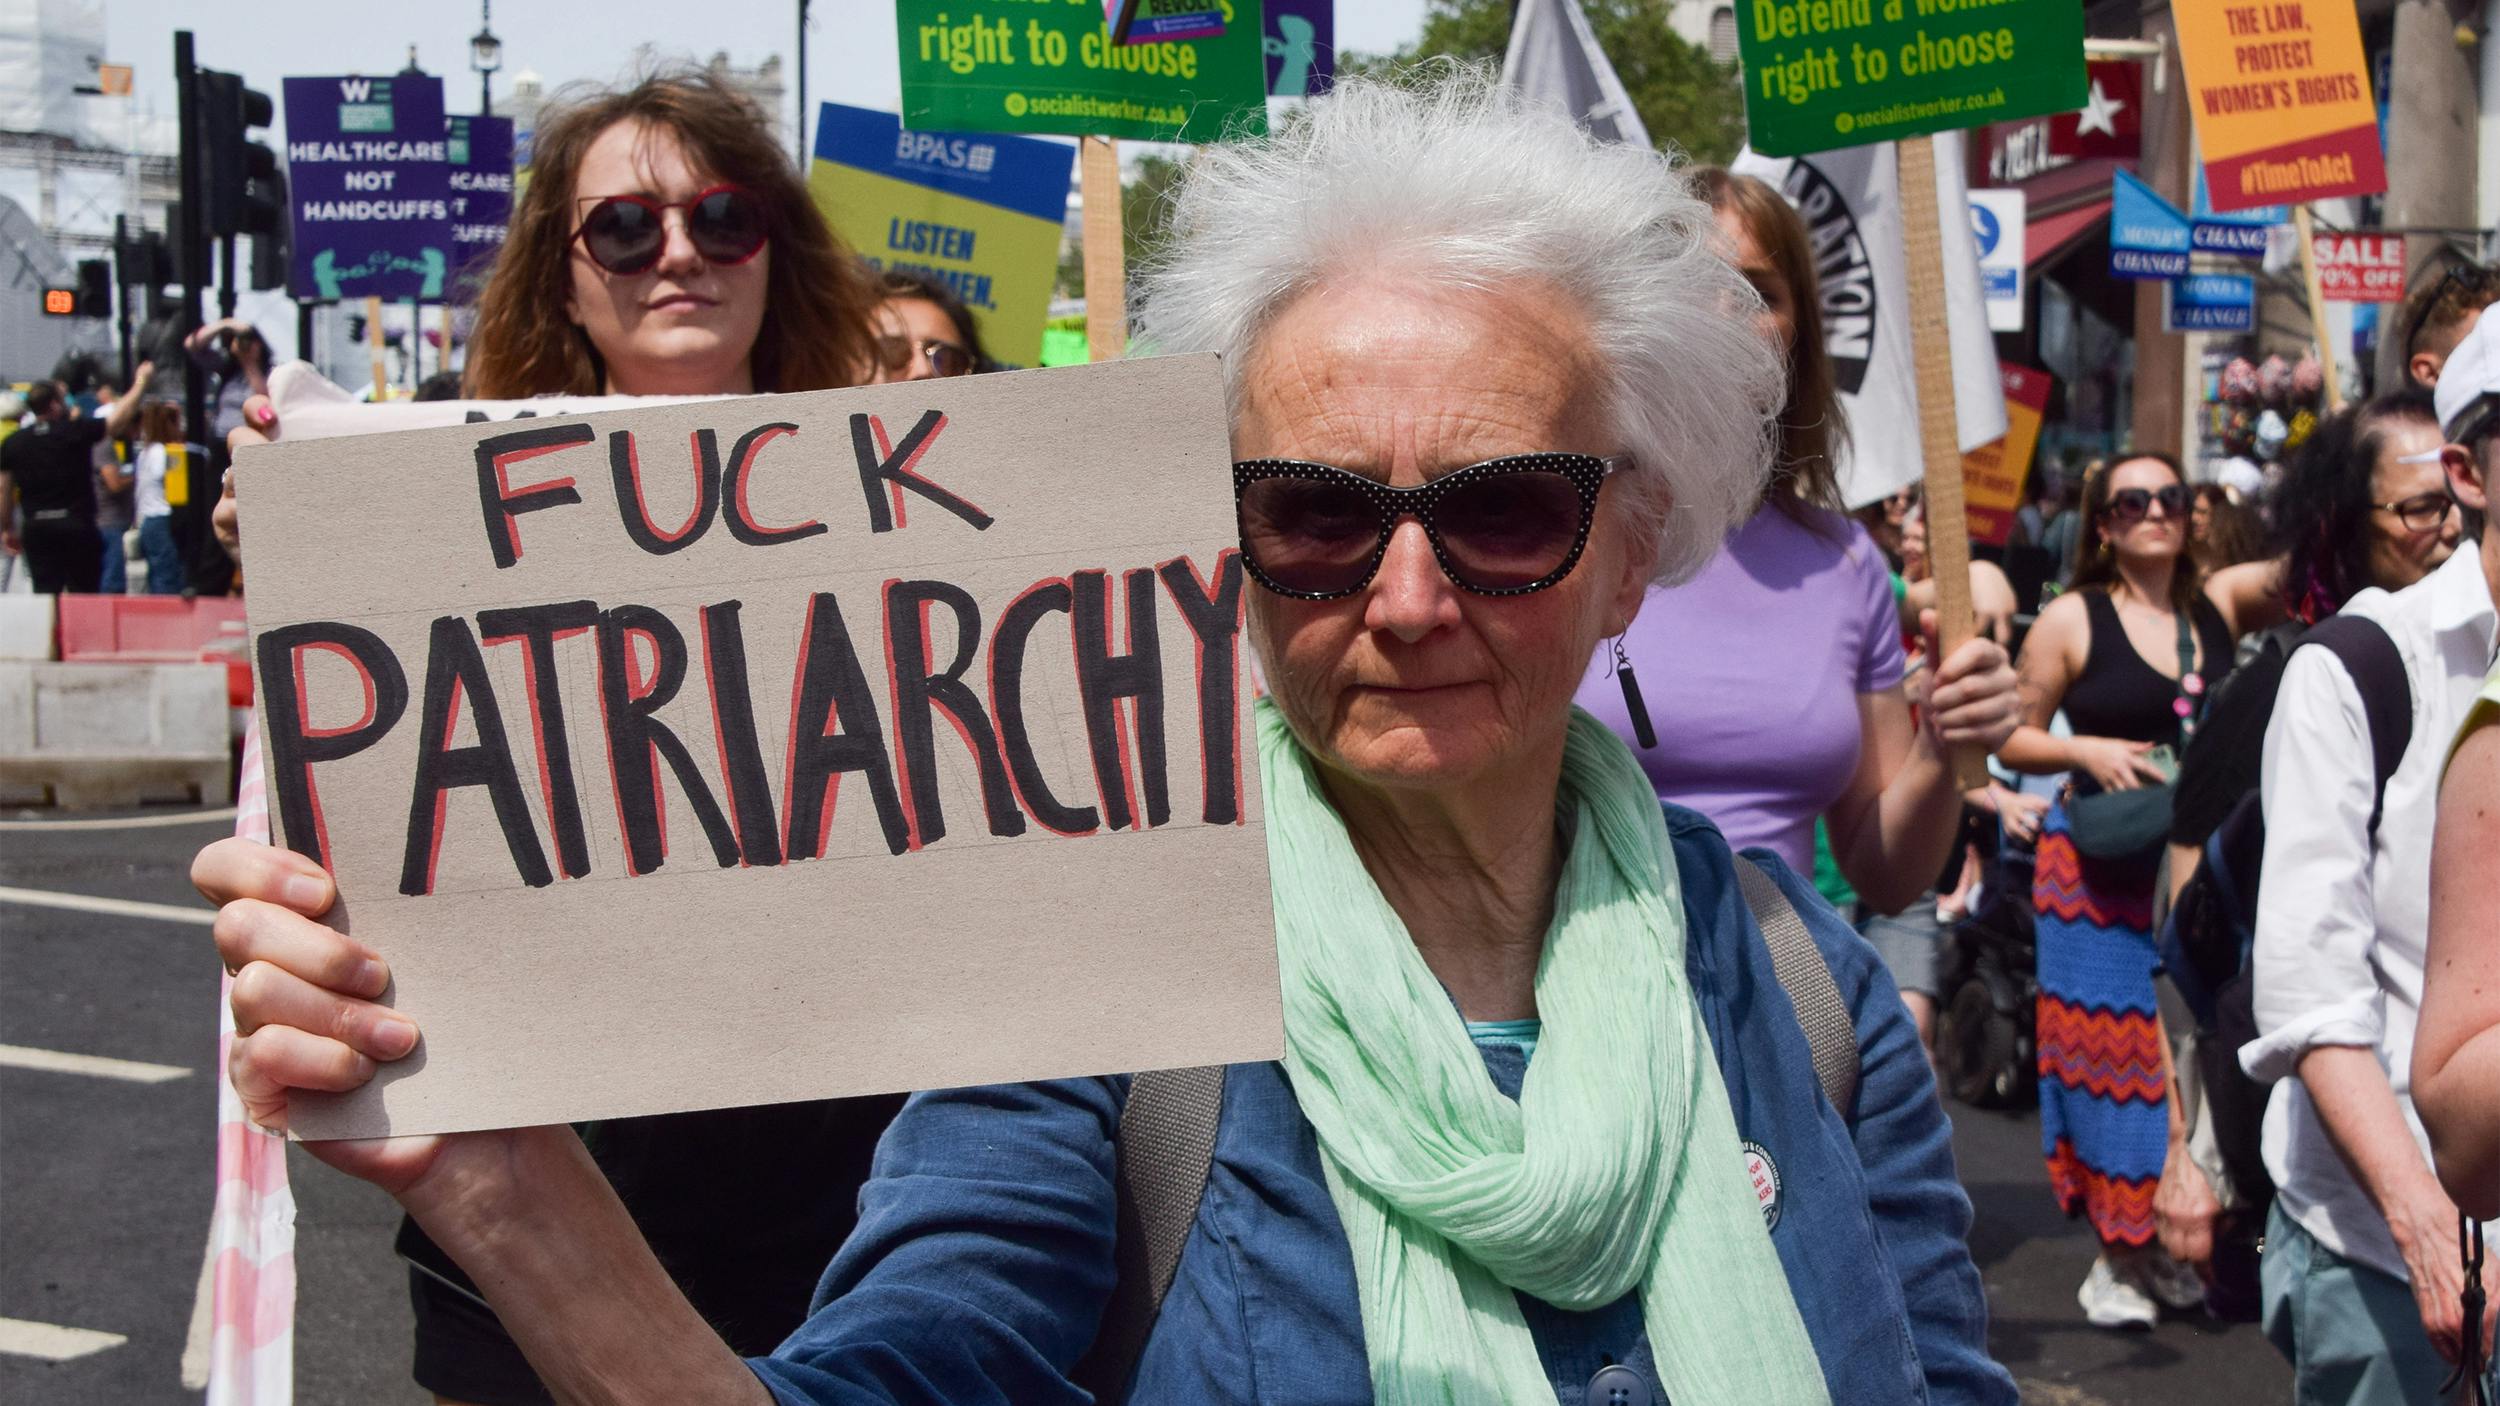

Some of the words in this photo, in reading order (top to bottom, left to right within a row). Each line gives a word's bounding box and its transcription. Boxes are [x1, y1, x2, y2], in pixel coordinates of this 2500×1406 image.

[2225, 8, 2260, 36] THE
[919, 13, 1014, 73] right
[1026, 18, 1068, 66] to
[2235, 40, 2313, 73] PROTECT
[1760, 47, 1841, 105] right
[1851, 42, 1888, 84] to
[1900, 27, 2015, 77] choose
[1030, 93, 1187, 125] socialistworker.co.uk
[1855, 87, 2006, 129] socialistworker.co.uk
[2201, 80, 2293, 117] WOMEN'S
[2296, 73, 2360, 106] RIGHTS
[289, 141, 447, 162] HEALTHCARE
[896, 130, 966, 168] BPAS
[344, 171, 395, 191] NOT
[2240, 151, 2354, 196] #TimeToAct
[303, 199, 447, 222] HANDCUFFS
[889, 218, 976, 262] LISTEN
[2192, 224, 2267, 248] CHANG
[2313, 237, 2400, 266] SALE
[2112, 251, 2187, 275] CHANGE
[475, 409, 995, 568] FUCK
[258, 547, 1246, 896] PATRIARCHY
